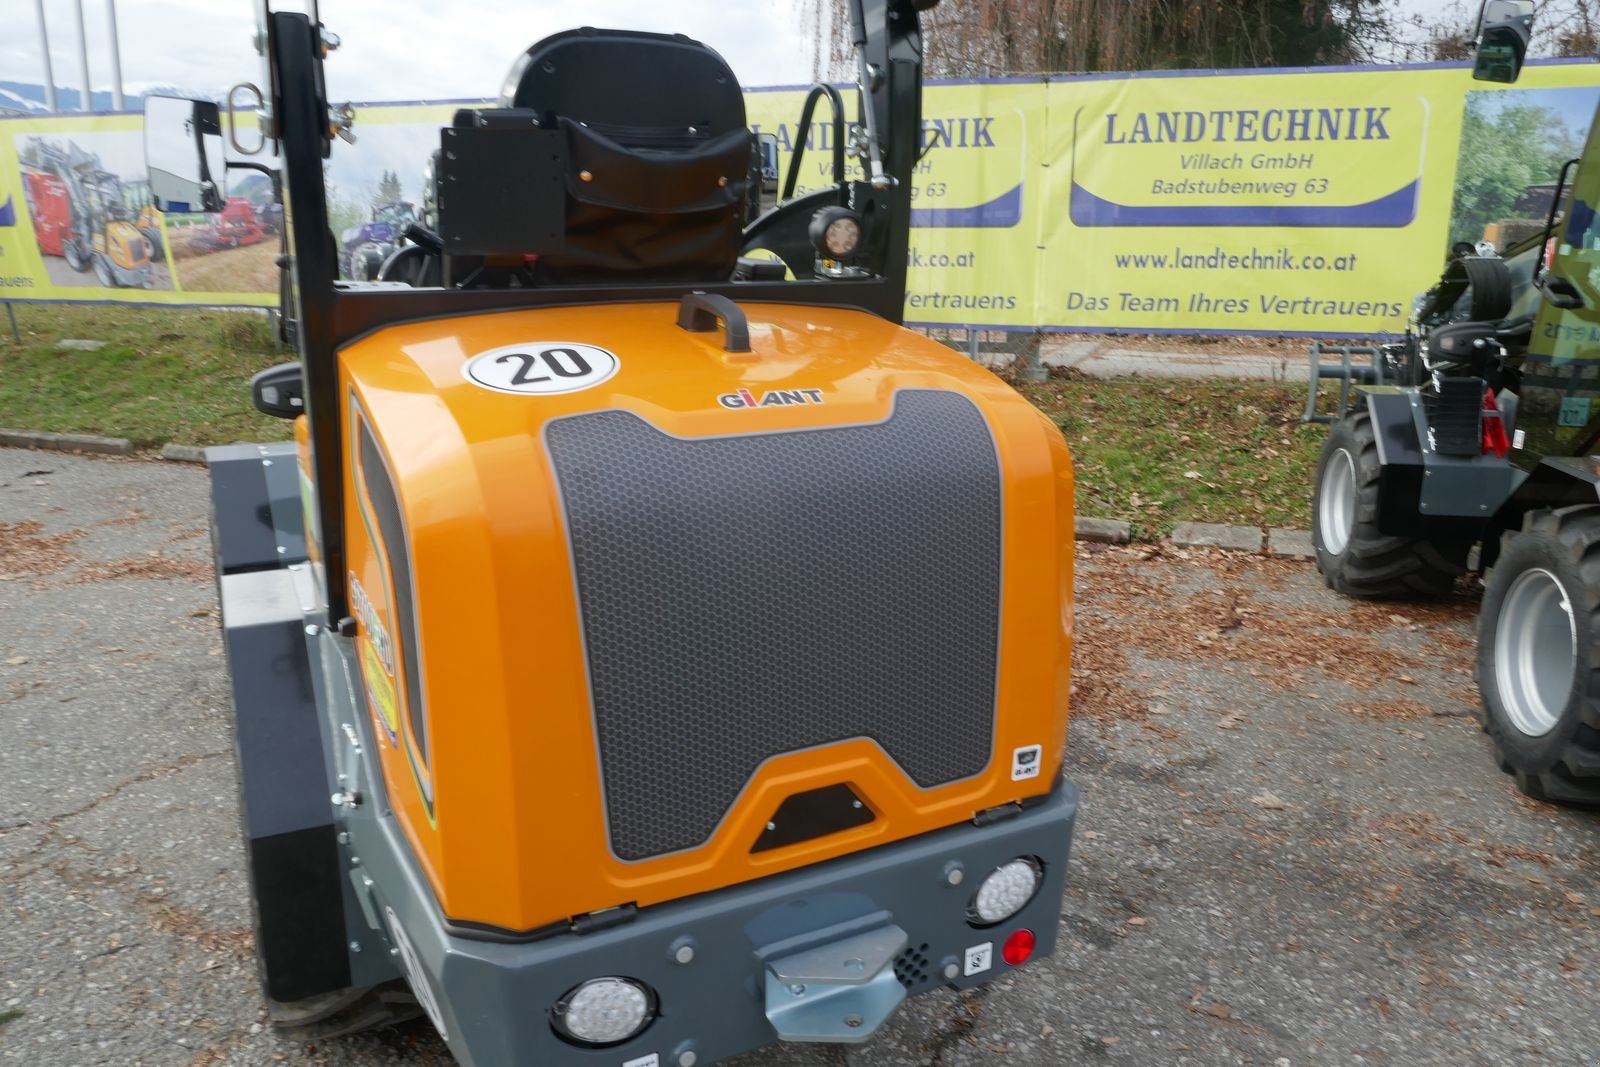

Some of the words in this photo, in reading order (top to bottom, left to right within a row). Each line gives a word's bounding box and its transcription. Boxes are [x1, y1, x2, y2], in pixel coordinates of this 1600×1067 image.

[1104, 107, 1391, 145] LANDTECHNIK
[1180, 153, 1243, 170] Villach
[1250, 153, 1314, 169] GmbH
[927, 182, 946, 197] 63
[1151, 179, 1297, 197] Badstubenweg
[1304, 178, 1329, 194] 63
[1115, 247, 1357, 271] www.landtechnik.co.at
[1066, 292, 1110, 311] Das
[1119, 293, 1180, 312] Team
[1188, 294, 1249, 313] Ihres
[1259, 295, 1403, 317] Vertrauens
[495, 347, 593, 385] 20
